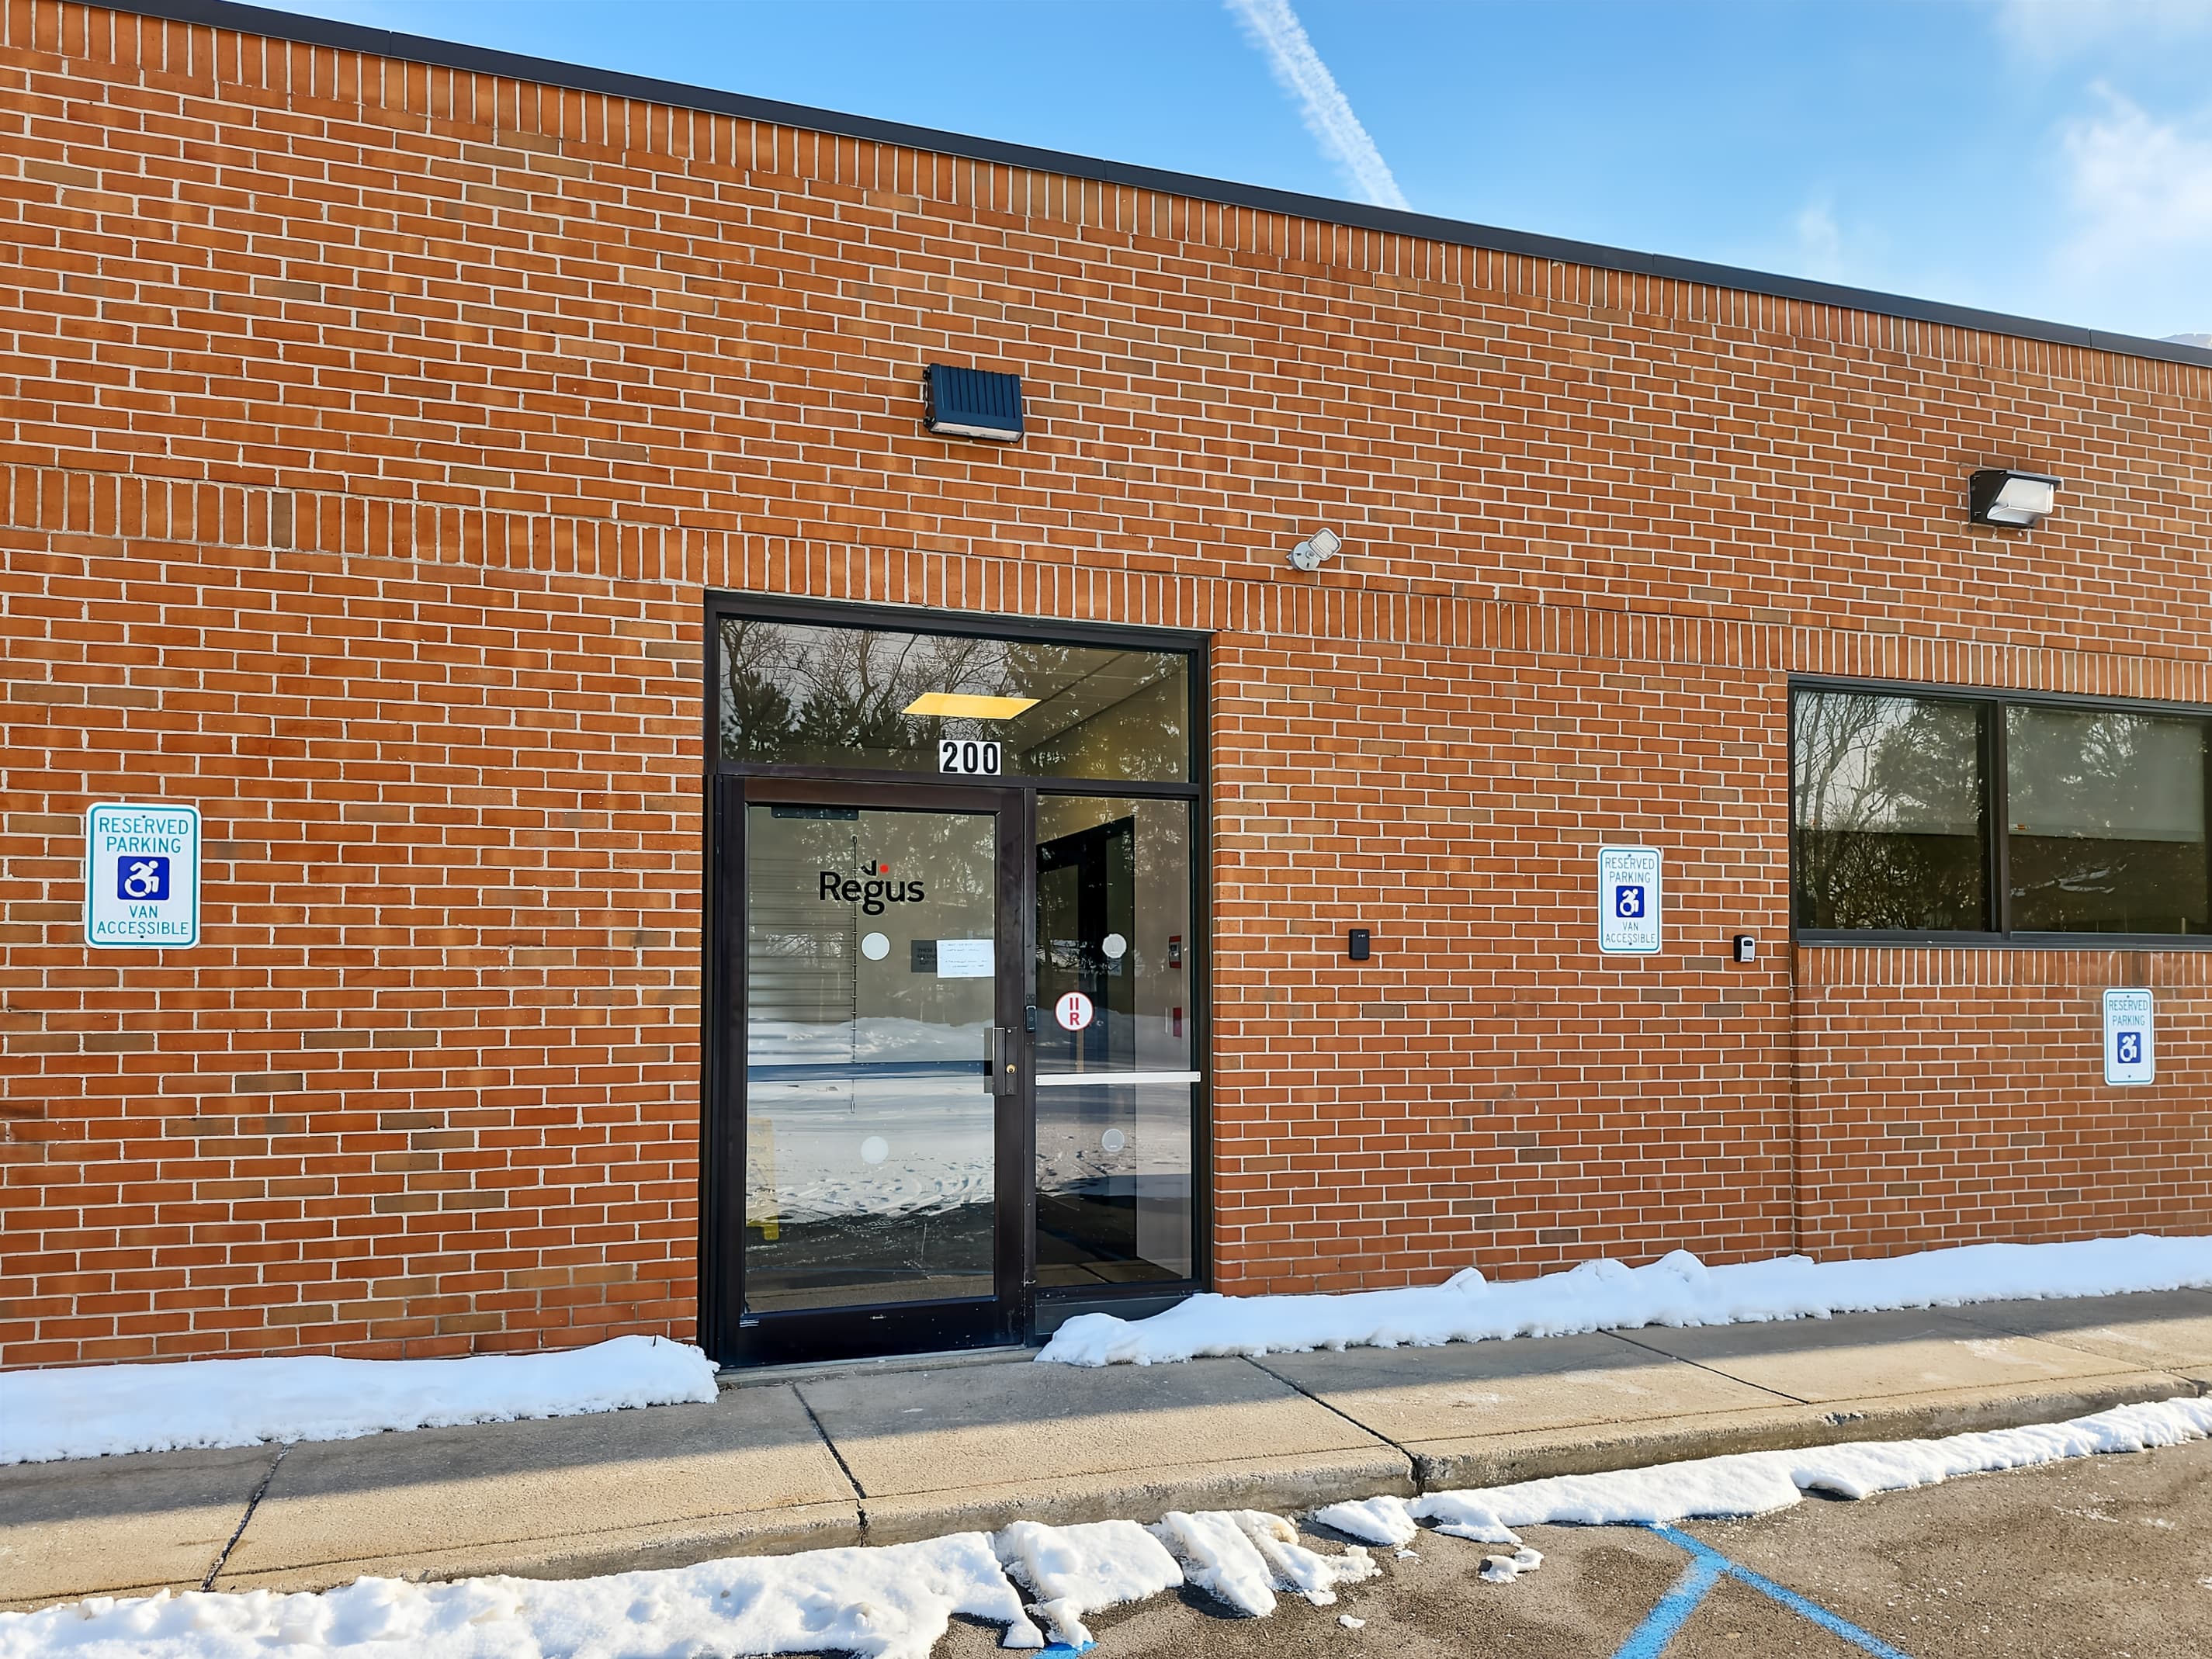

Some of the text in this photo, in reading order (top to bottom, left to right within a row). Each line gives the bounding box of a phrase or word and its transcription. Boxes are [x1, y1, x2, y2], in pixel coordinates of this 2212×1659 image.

[943, 742, 997, 774] 200
[99, 817, 189, 835] RESERVED
[106, 836, 181, 854] PARKING
[1605, 857, 1655, 870] RESERVED
[1609, 871, 1651, 883] PARKING
[820, 871, 925, 916] Regus
[129, 905, 158, 918] VAN
[96, 921, 189, 935] ACCESSIBLE
[1622, 922, 1638, 931] VAN
[1605, 933, 1656, 944] ACCESSIBLE
[2109, 999, 2148, 1011] RESERVED
[1070, 1012, 1080, 1026] R
[2112, 1015, 2145, 1026] PARKING
